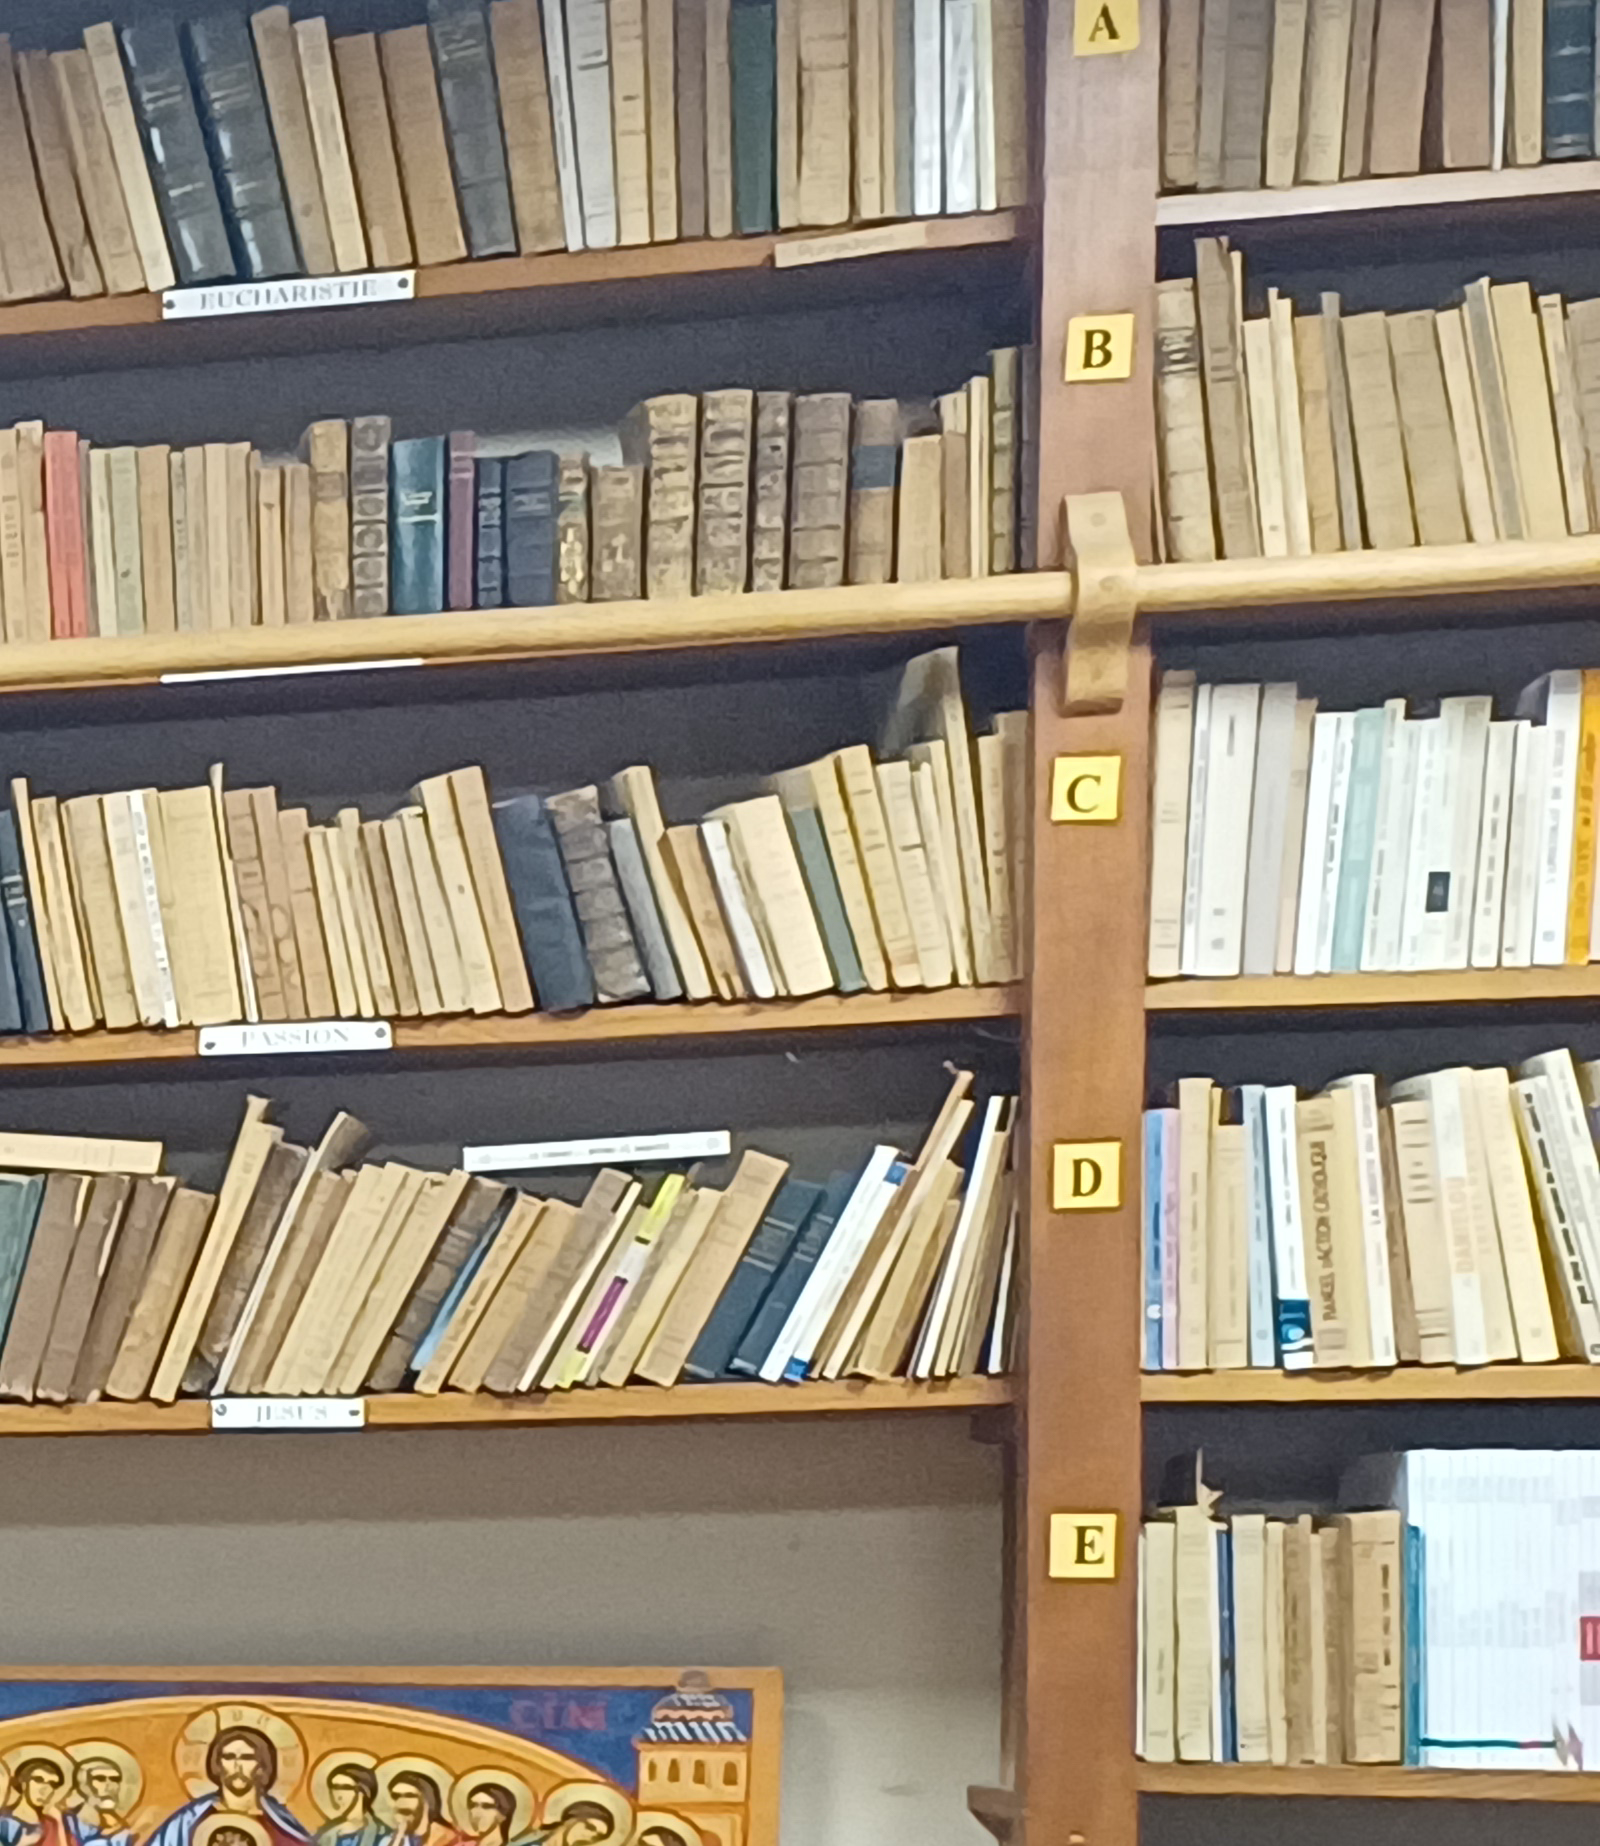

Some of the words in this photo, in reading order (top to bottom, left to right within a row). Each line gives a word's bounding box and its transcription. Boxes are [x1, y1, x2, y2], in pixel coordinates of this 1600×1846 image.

[1090, 4, 1119, 41] A
[200, 279, 377, 310] EUCHARISTIE
[1083, 330, 1112, 369] B
[1067, 775, 1101, 813] C
[1072, 1159, 1101, 1196] D
[1075, 1526, 1104, 1564] E
